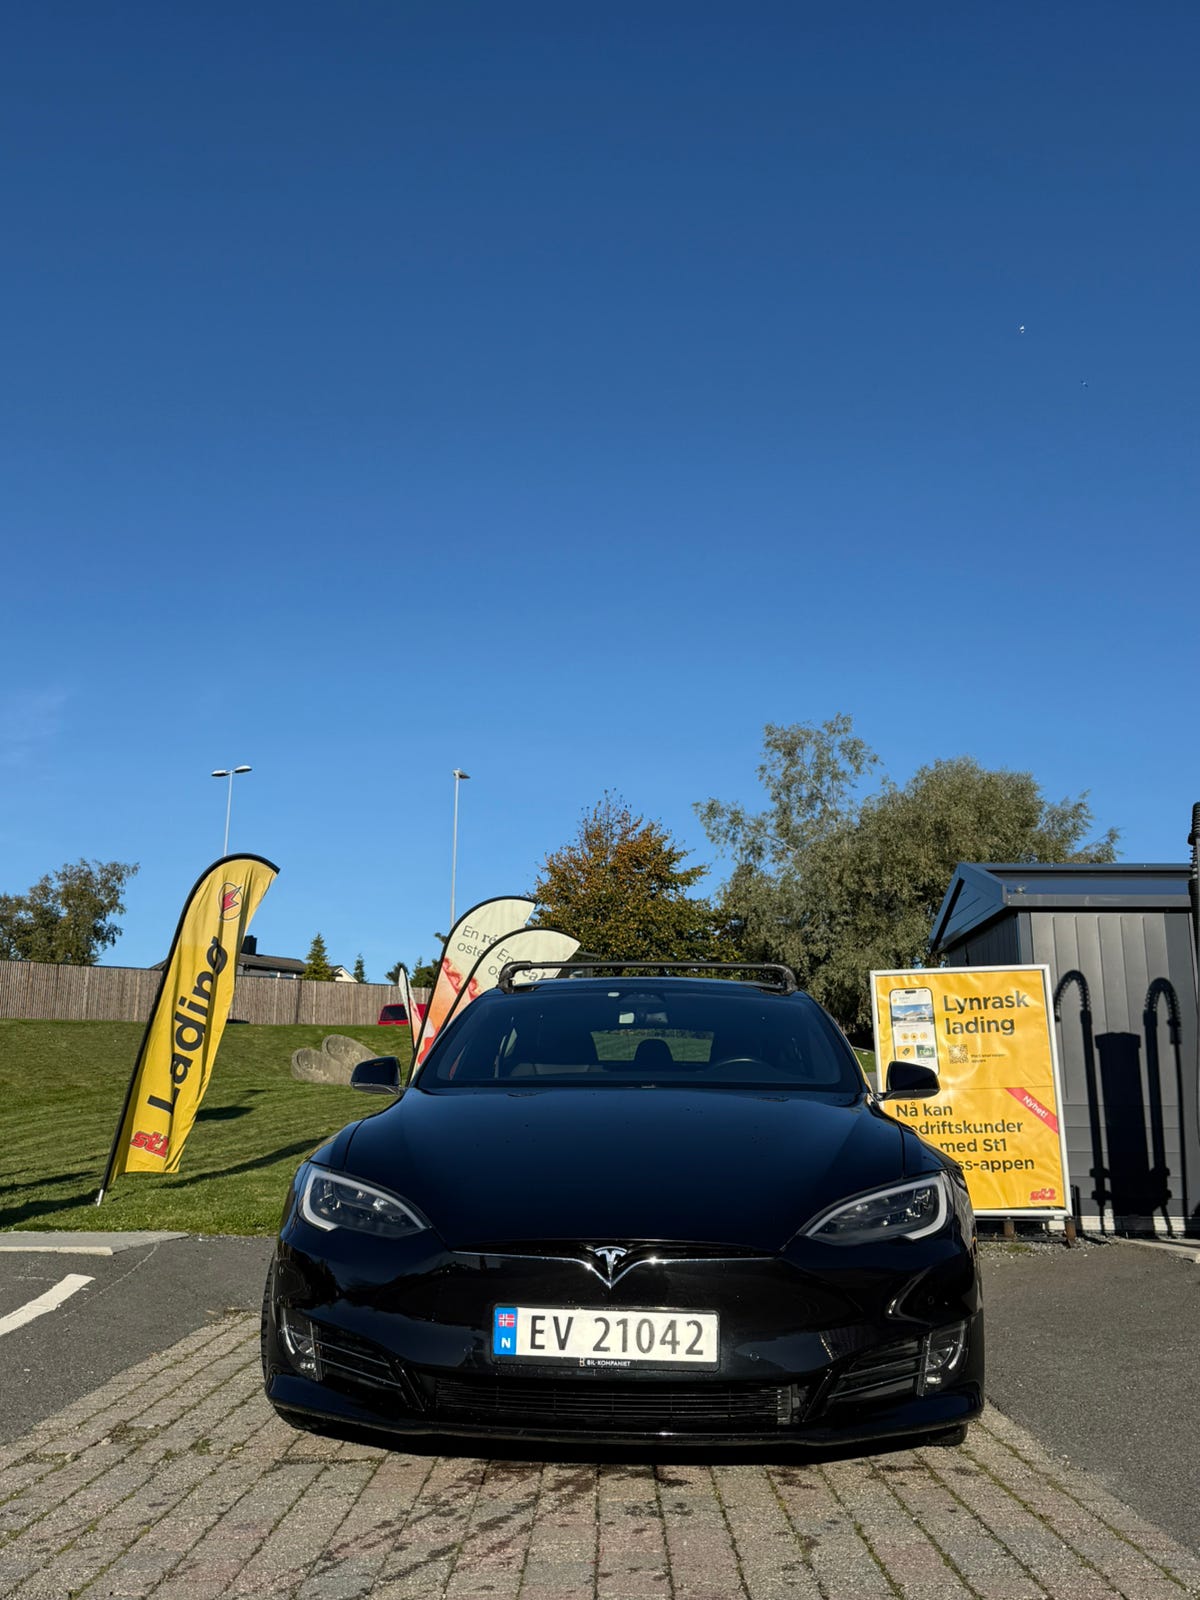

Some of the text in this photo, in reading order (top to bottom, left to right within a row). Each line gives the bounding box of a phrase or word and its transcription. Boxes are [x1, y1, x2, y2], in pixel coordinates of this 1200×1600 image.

[462, 925, 479, 940] En
[943, 990, 1030, 1014] Lynrask
[945, 1016, 1015, 1036] lading
[896, 1102, 953, 1118] Nå kan
[1023, 1095, 1049, 1119] Nyhet!
[940, 1138, 1007, 1153] med St1
[501, 1337, 511, 1349] N
[529, 1315, 704, 1356] EV 21042
